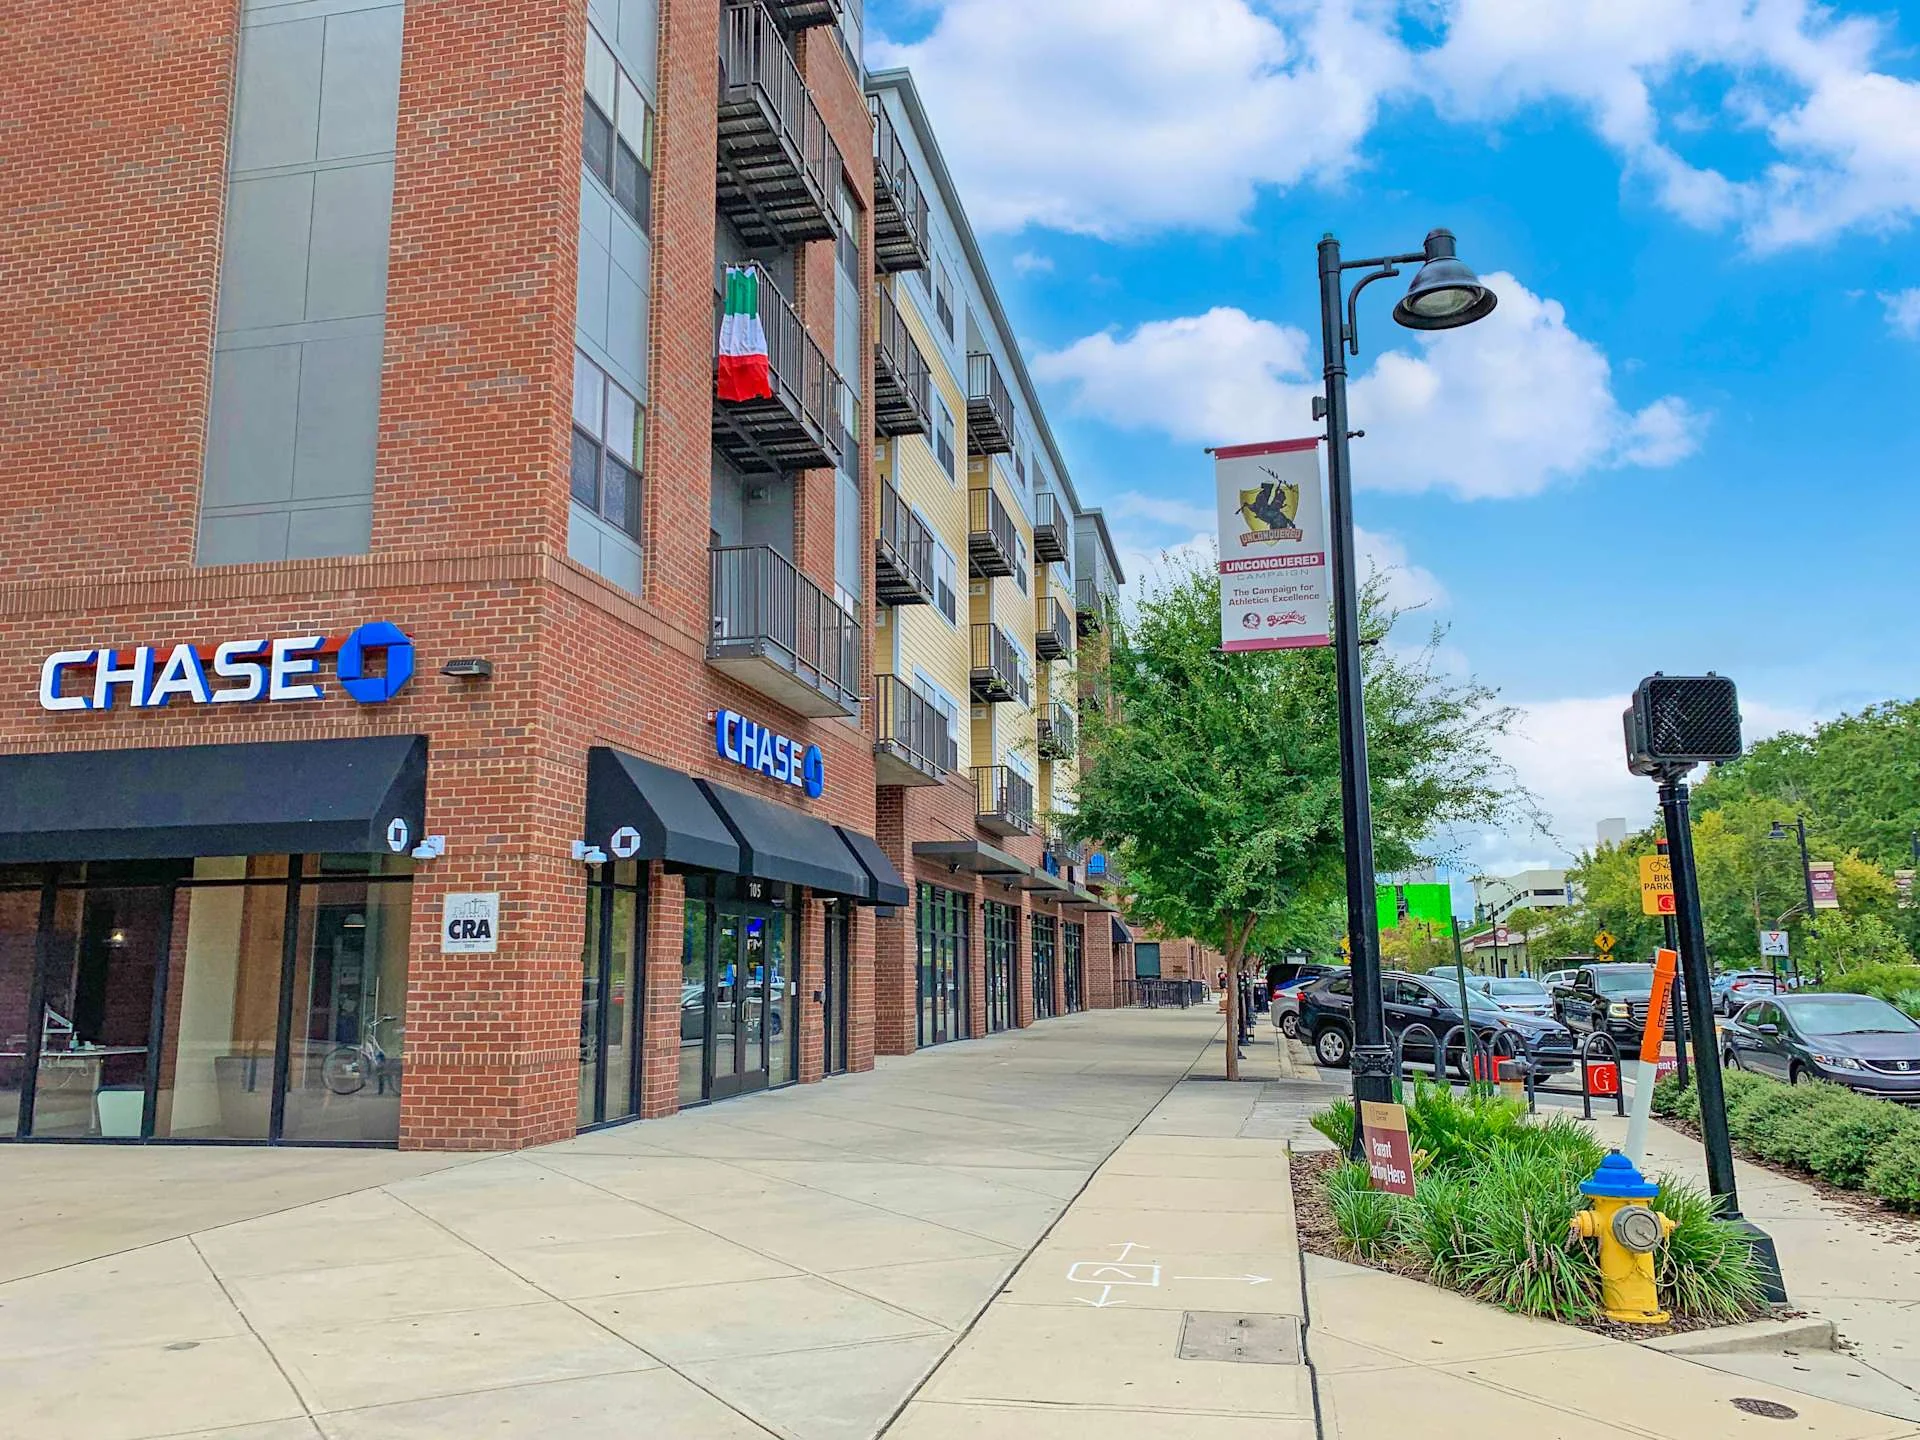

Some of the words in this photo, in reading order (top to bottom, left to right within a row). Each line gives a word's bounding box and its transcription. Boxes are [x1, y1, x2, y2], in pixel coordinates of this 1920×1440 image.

[1241, 529, 1301, 542] UNCONQUERED
[1226, 555, 1319, 572] UNCONQUERED
[1236, 569, 1309, 581] CAMPAIGN
[1233, 588, 1249, 597] The
[1252, 584, 1297, 596] Campaign
[1300, 583, 1314, 592] for
[1228, 597, 1269, 606] Athletics
[1272, 592, 1320, 603] Excellence
[40, 636, 326, 710] CHASE
[717, 708, 803, 788] CHASE
[1654, 874, 1671, 882] BIK
[749, 883, 762, 898] 105
[448, 919, 491, 939] CRA
[1372, 1138, 1392, 1159] Parent
[1387, 1164, 1406, 1185] Here
